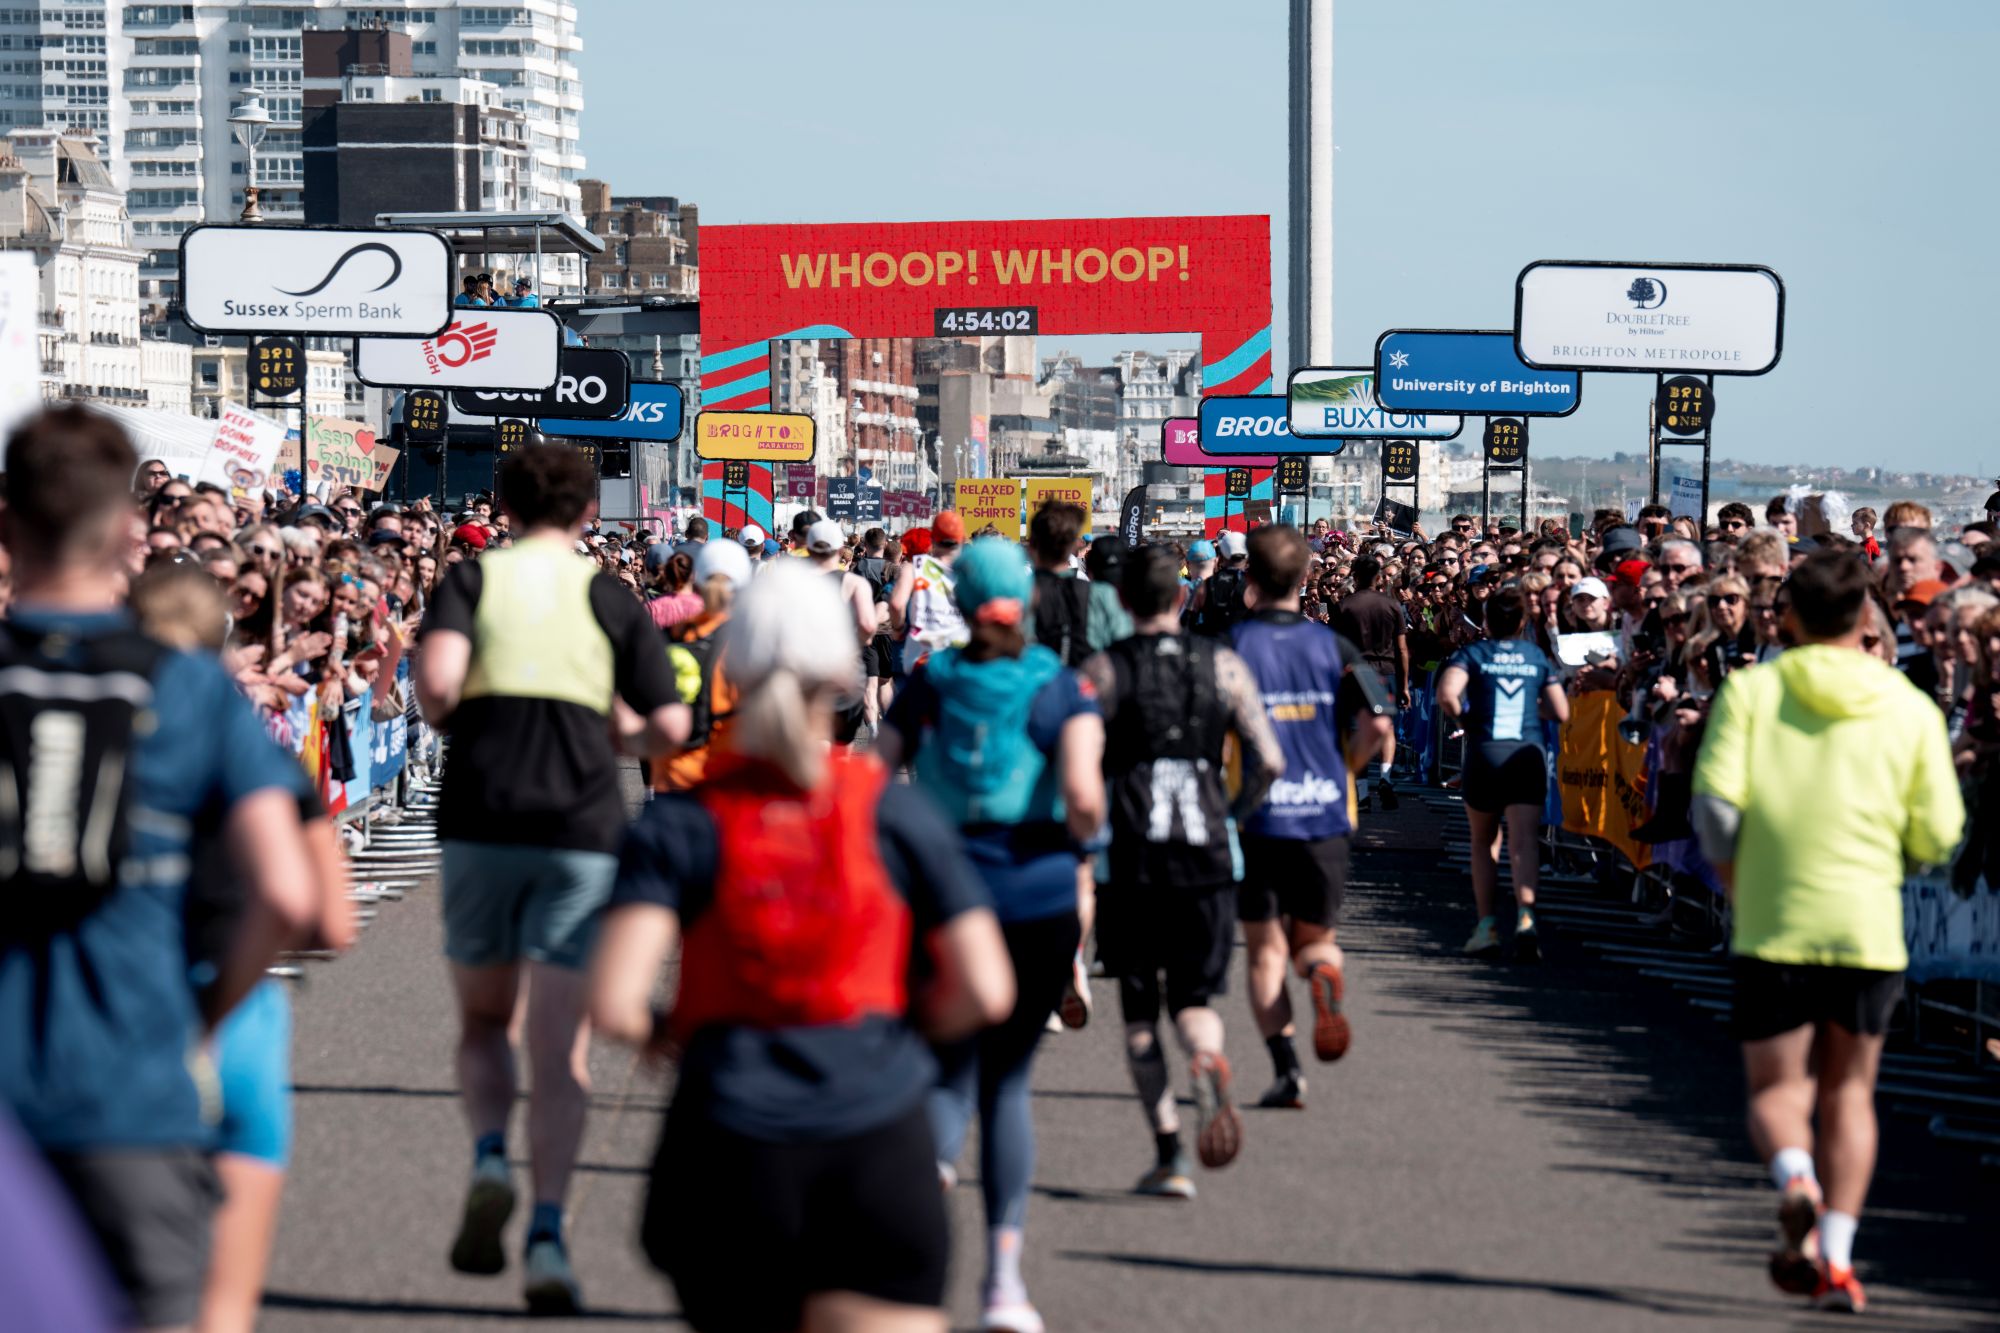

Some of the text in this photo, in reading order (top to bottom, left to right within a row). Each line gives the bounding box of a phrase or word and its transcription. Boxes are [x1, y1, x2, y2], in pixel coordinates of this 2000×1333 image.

[780, 244, 1191, 289] WHOOP! WHOOP!
[224, 300, 402, 321] Sussex Sperm Bank
[942, 309, 1031, 331] 4:54:02
[1628, 327, 1665, 337] by Hilton
[421, 340, 441, 375] HIGH
[1552, 345, 1742, 361] BRIGHTON METROPOLE
[1392, 378, 1571, 396] University of Brighton
[1216, 415, 1291, 437] BROO
[1324, 406, 1427, 429] BUXTON
[707, 423, 804, 439] BRIGHTON
[321, 463, 361, 485] STU
[797, 482, 807, 494] G
[960, 485, 1015, 495] RELAXED
[1038, 490, 1081, 500] FITTED
[978, 496, 996, 506] FIT
[959, 507, 1015, 518] T-SHIRTS
[1128, 505, 1140, 552] etPRO
